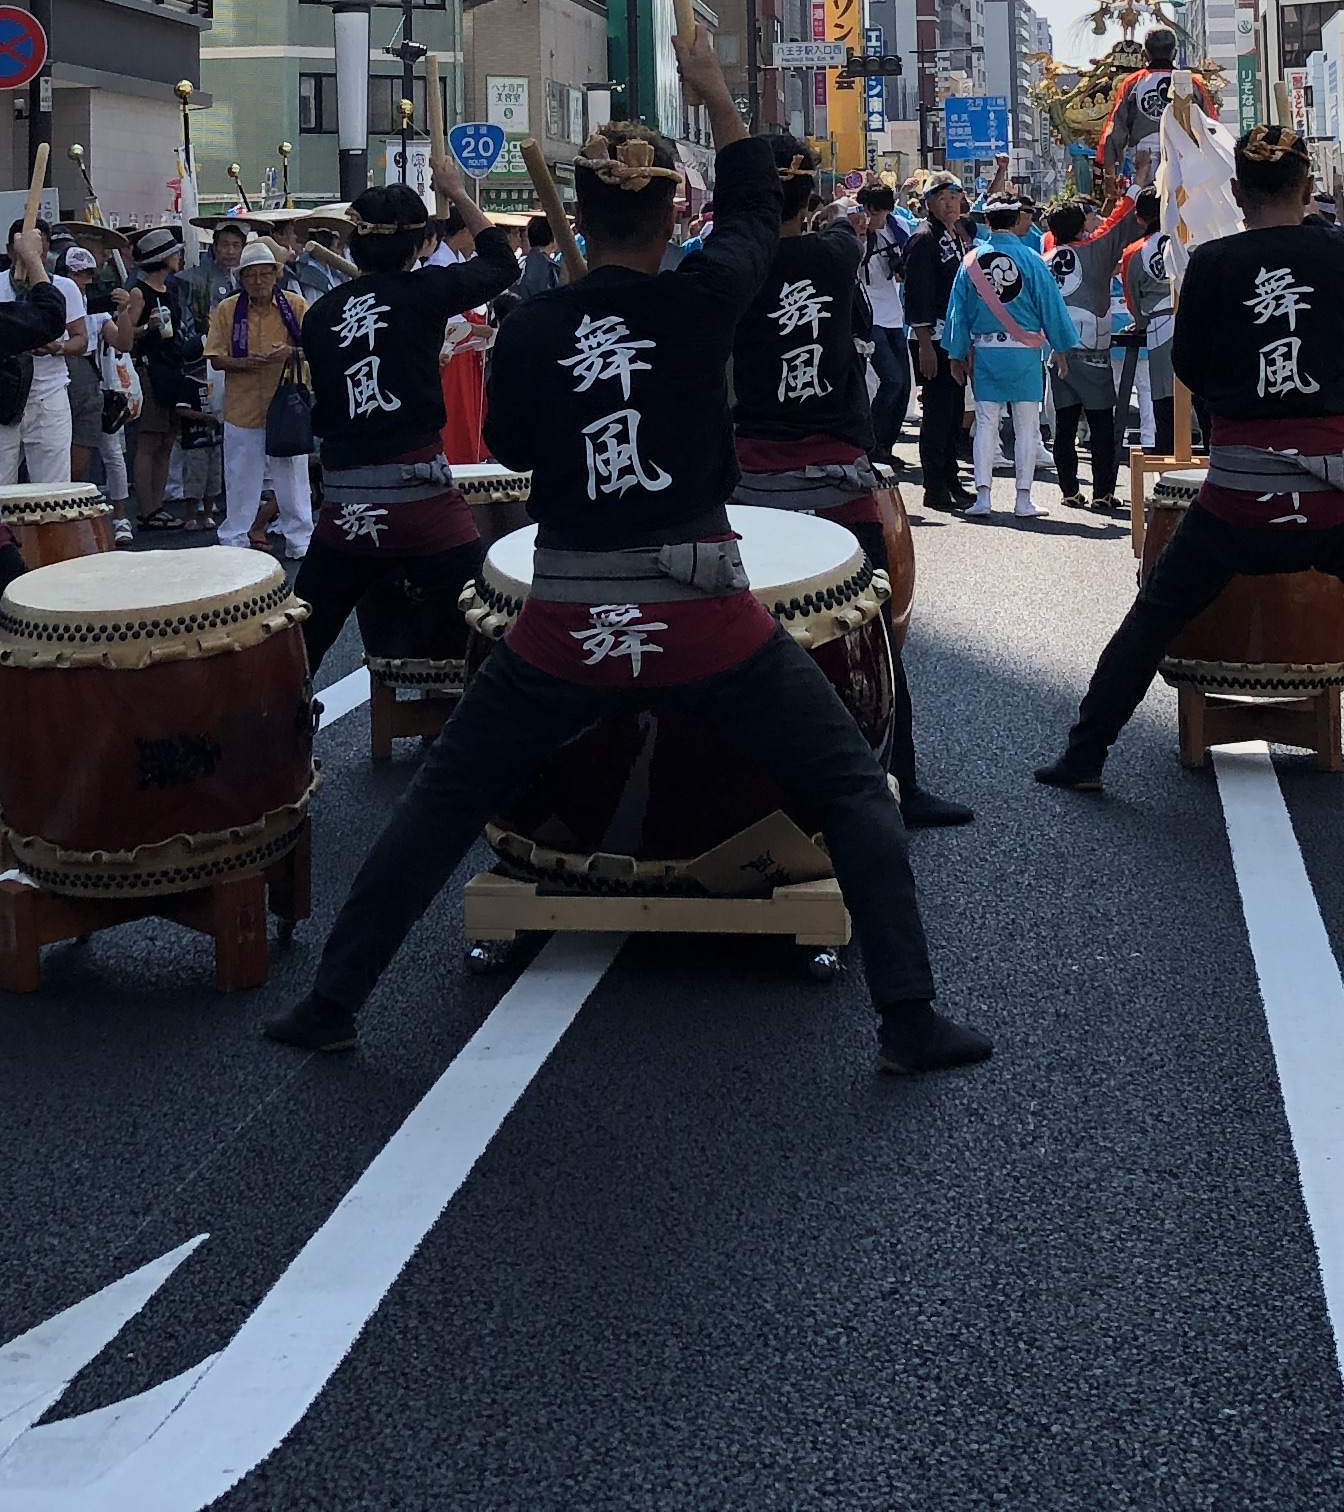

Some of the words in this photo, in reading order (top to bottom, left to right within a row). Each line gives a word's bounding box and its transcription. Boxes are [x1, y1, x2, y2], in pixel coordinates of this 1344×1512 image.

[777, 45, 842, 55] 八王子駅入口西
[1240, 69, 1256, 131] りそな銀行
[461, 137, 494, 158] 20
[557, 314, 673, 501] 舞風
[570, 603, 668, 678] 舞
